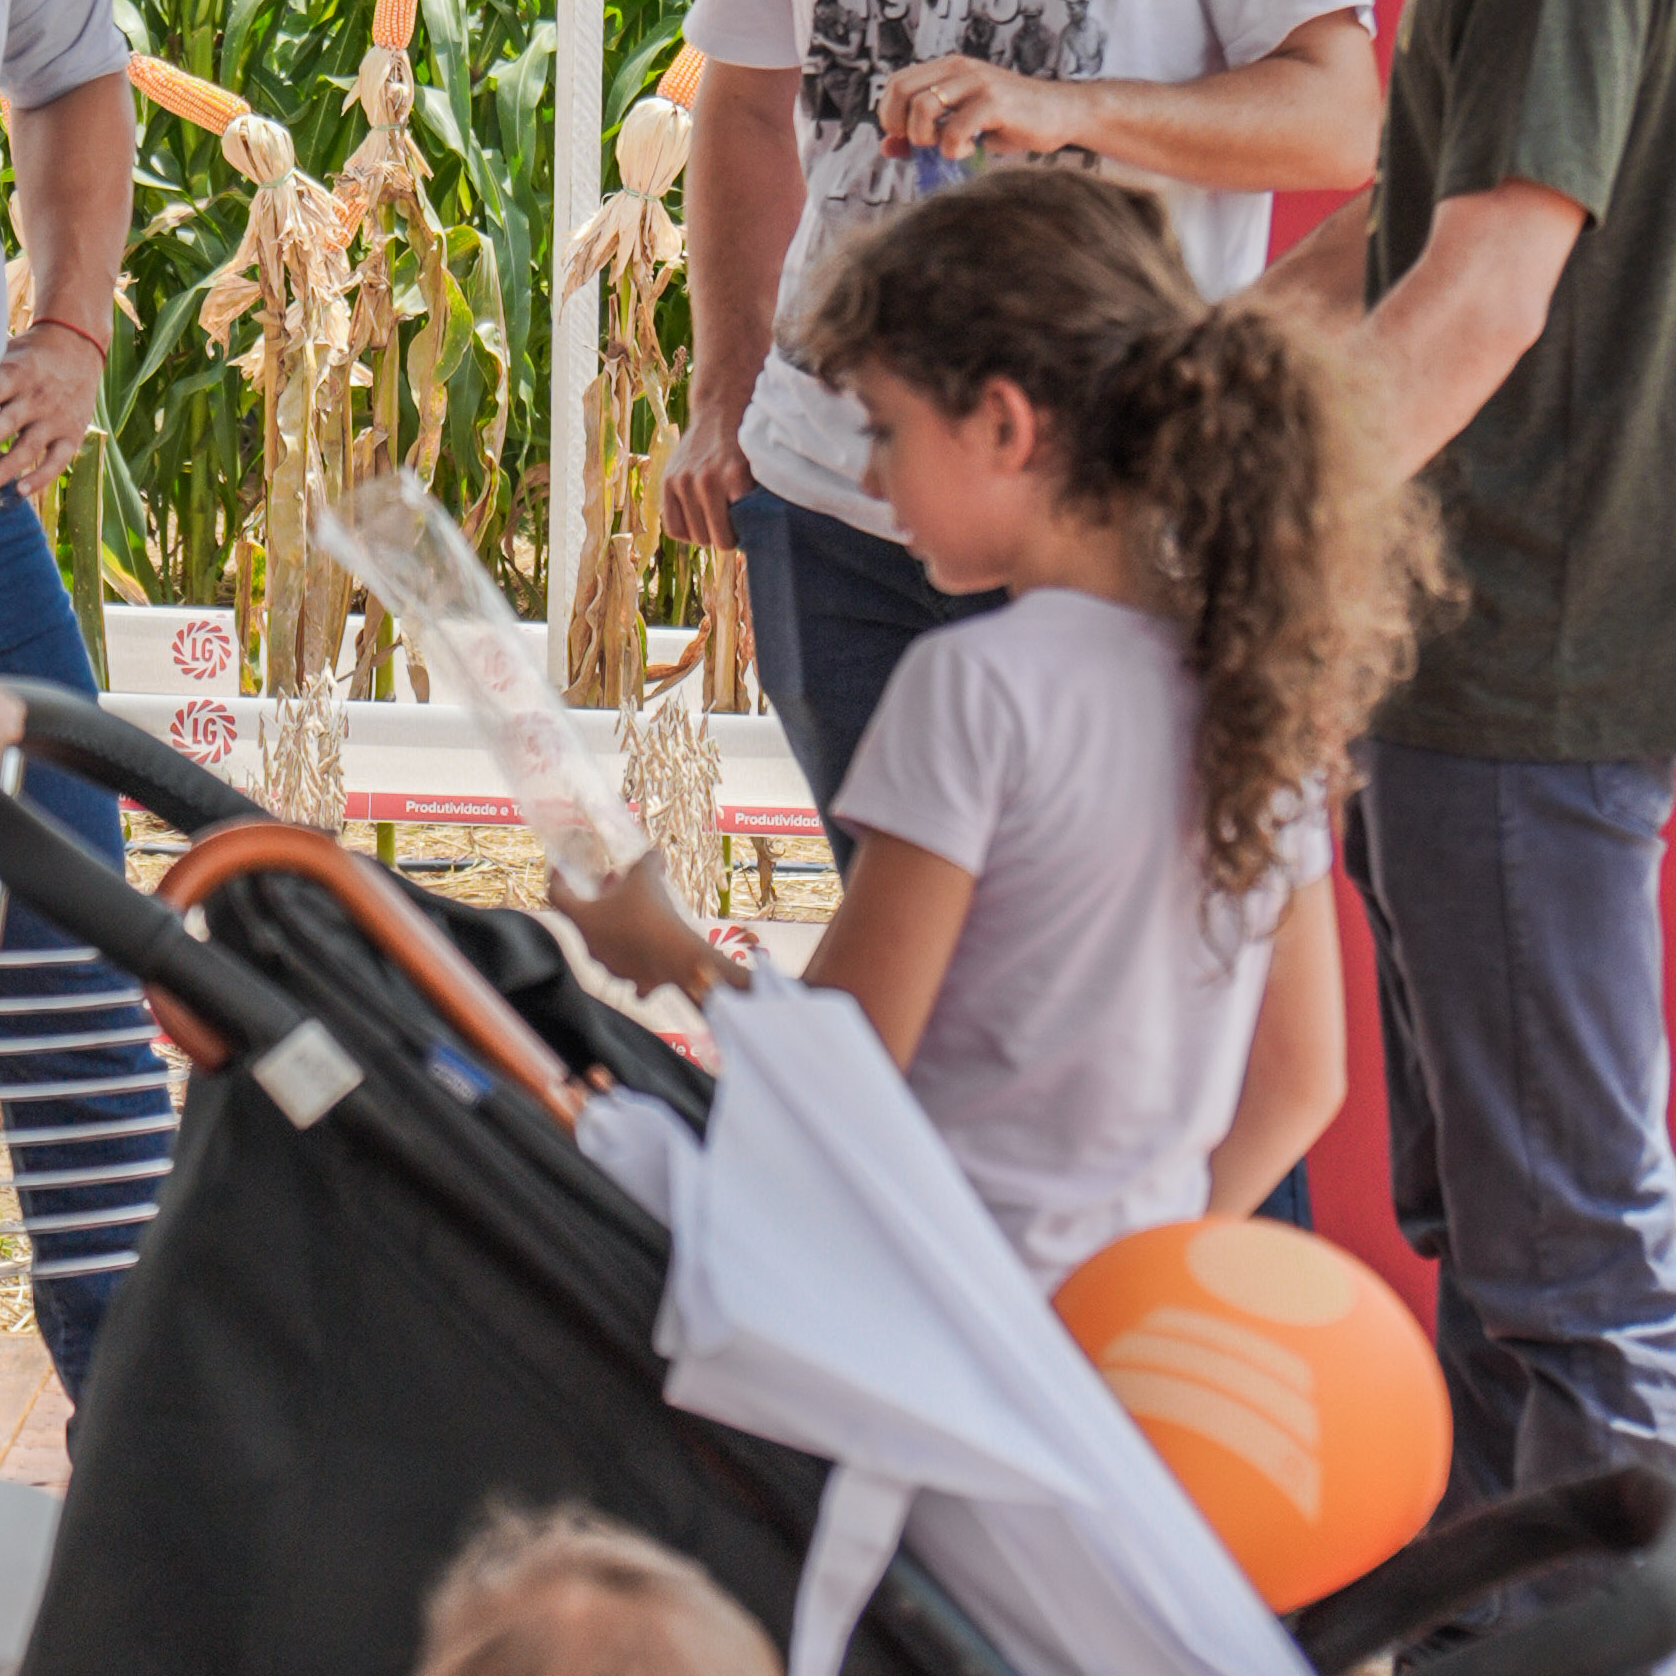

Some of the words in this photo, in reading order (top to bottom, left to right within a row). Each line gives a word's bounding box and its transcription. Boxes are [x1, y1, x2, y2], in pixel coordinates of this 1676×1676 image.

[191, 637, 214, 663] LG
[192, 717, 217, 745] LG
[405, 800, 497, 816] Produtividade
[500, 806, 509, 816] e
[735, 812, 823, 828] Produtividad
